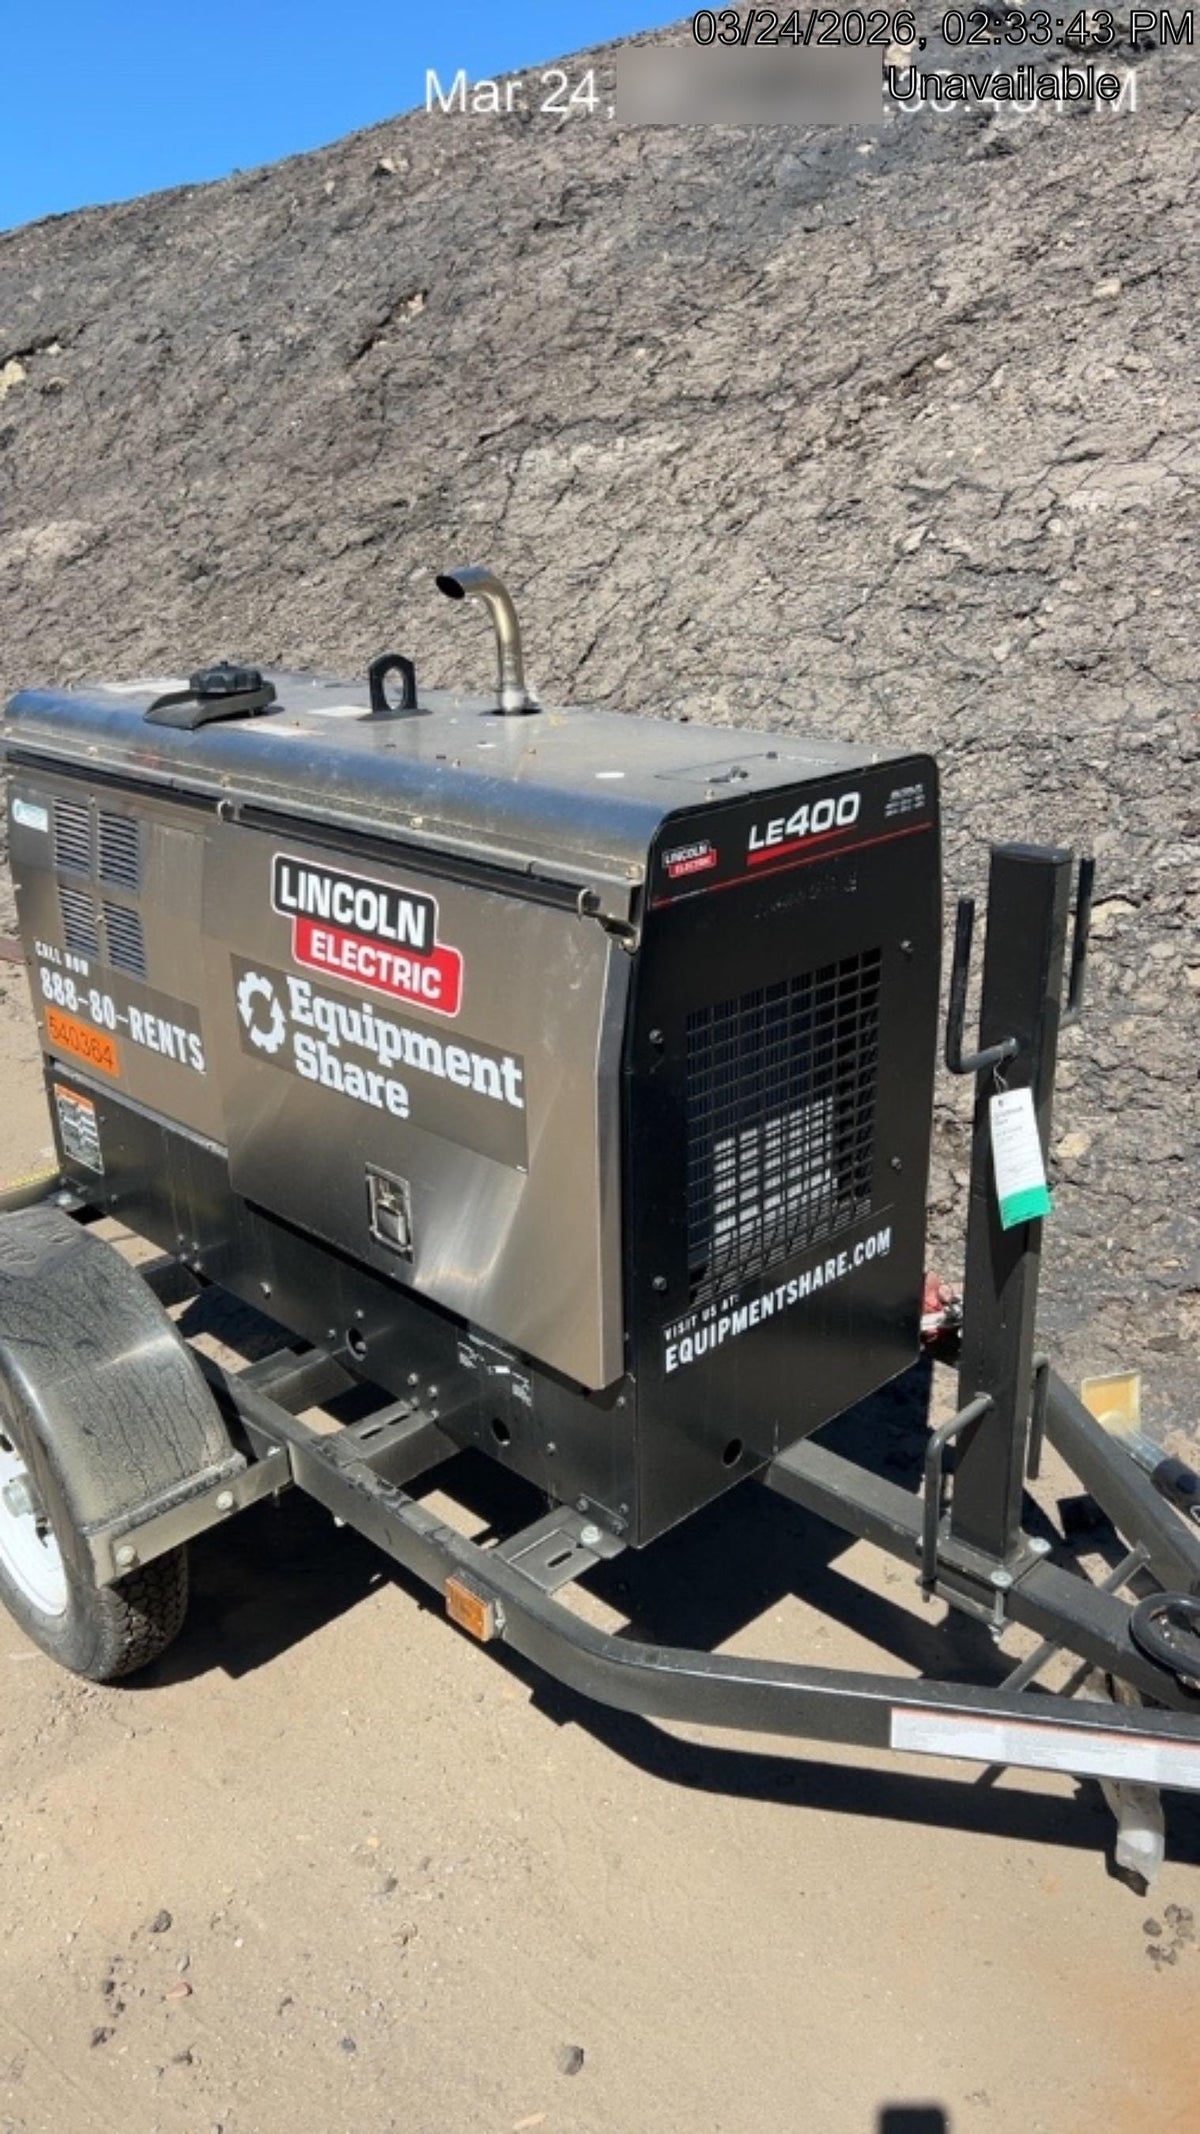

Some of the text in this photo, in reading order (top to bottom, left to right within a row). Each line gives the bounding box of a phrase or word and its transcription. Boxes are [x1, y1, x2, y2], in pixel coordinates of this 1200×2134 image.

[665, 844, 708, 865] LINCOLN
[748, 792, 861, 851] LE400
[280, 865, 426, 948] LINCOLN
[35, 940, 62, 966] CALL
[309, 928, 442, 999] ELECTRIC
[40, 966, 206, 1072] 888-80-RENTS
[286, 976, 524, 1109] Equipment
[294, 1034, 410, 1119] Share
[664, 1314, 698, 1341] VISIT
[701, 1303, 718, 1322] US
[665, 1226, 892, 1374] EQUIPMENTSHARE.COM
